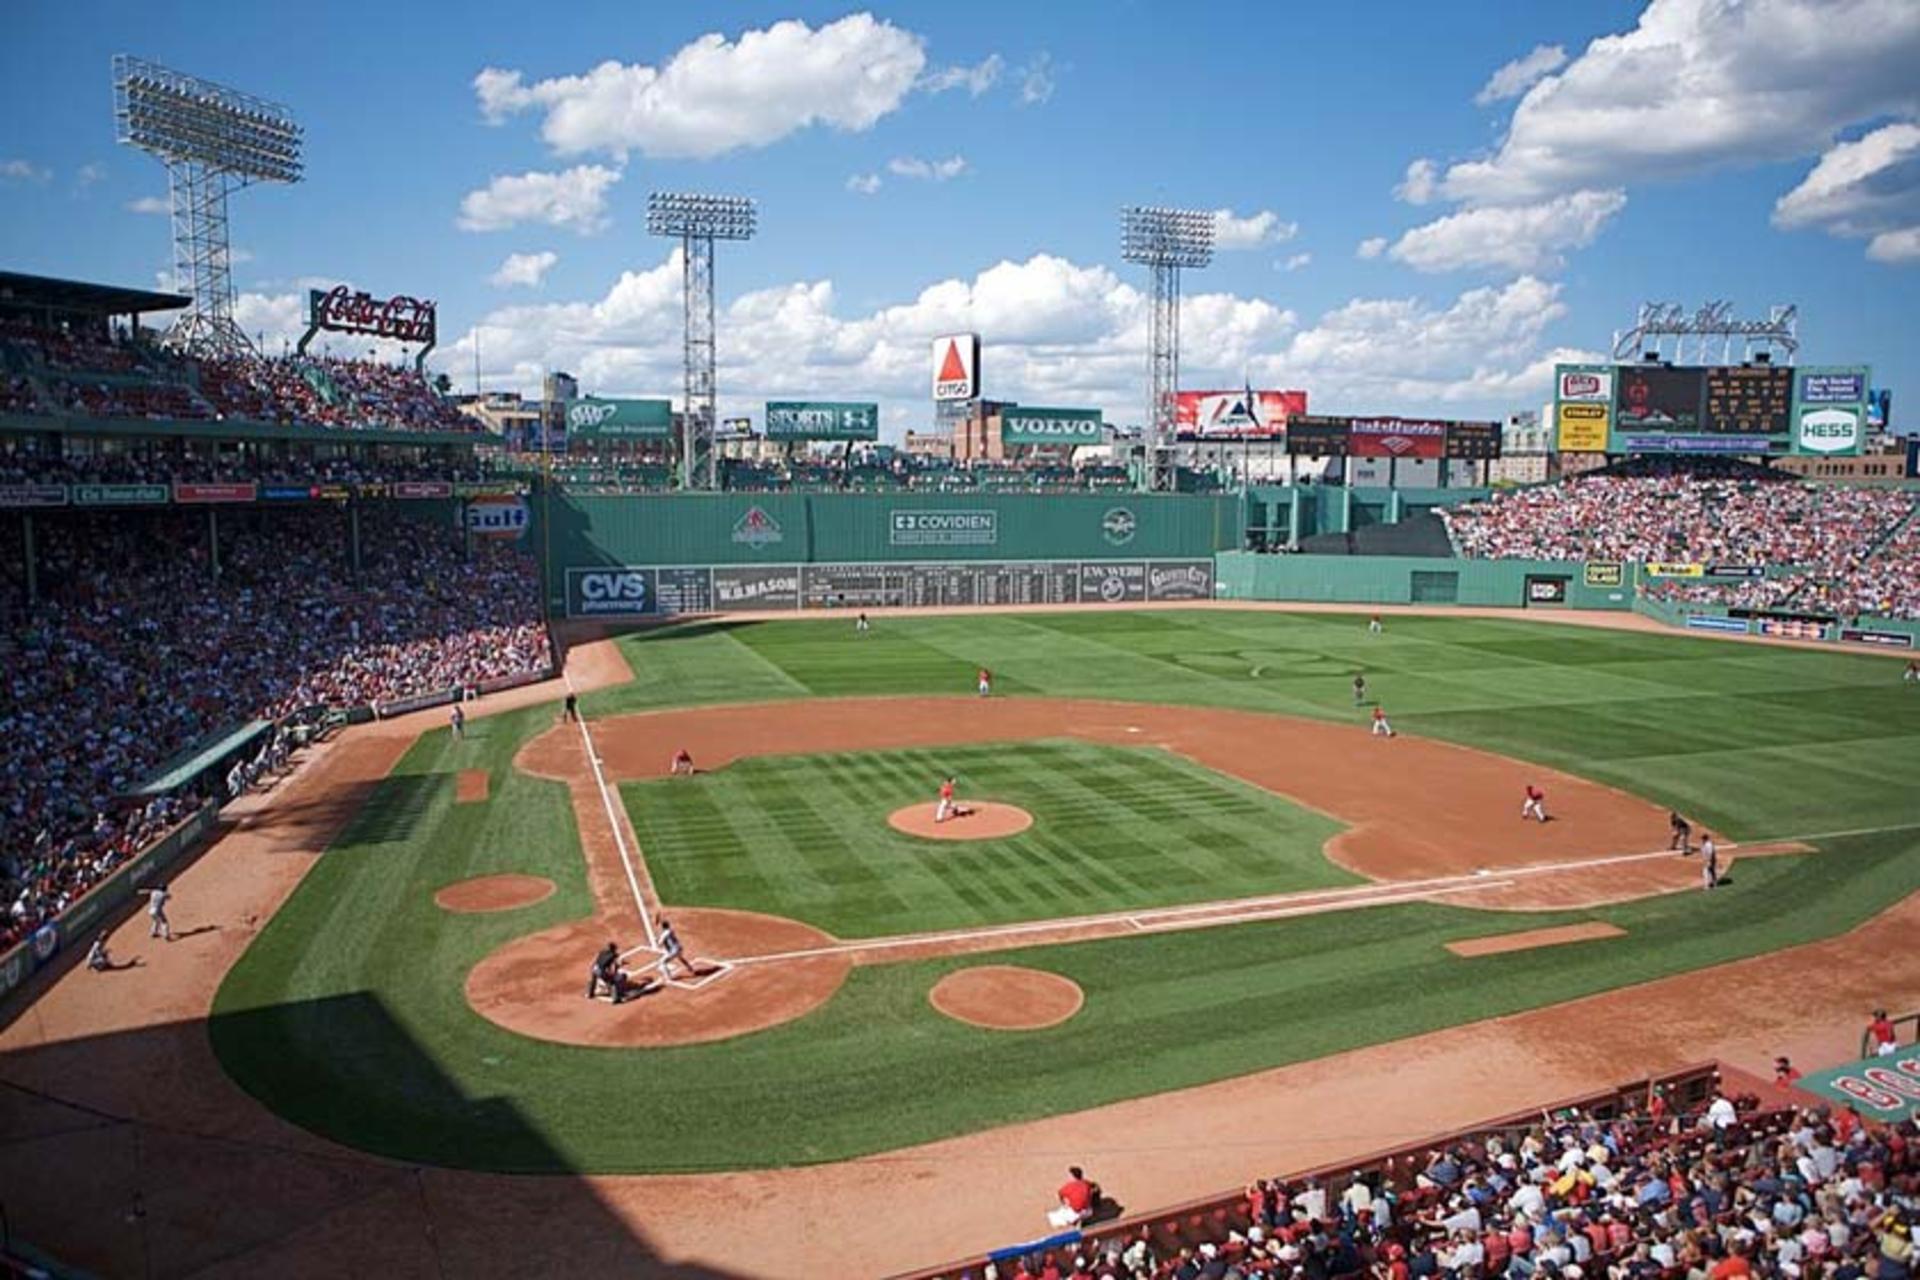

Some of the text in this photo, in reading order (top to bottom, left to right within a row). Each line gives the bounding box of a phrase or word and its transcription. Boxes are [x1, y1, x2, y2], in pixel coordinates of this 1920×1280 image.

[319, 285, 436, 342] Coca-Cola
[937, 383, 967, 397] CITGO
[1008, 417, 1097, 436] VOLVO
[1803, 422, 1853, 438] HESS
[468, 508, 525, 527] Gulf
[918, 515, 991, 529] COVIDIEN
[581, 573, 645, 599] CVS
